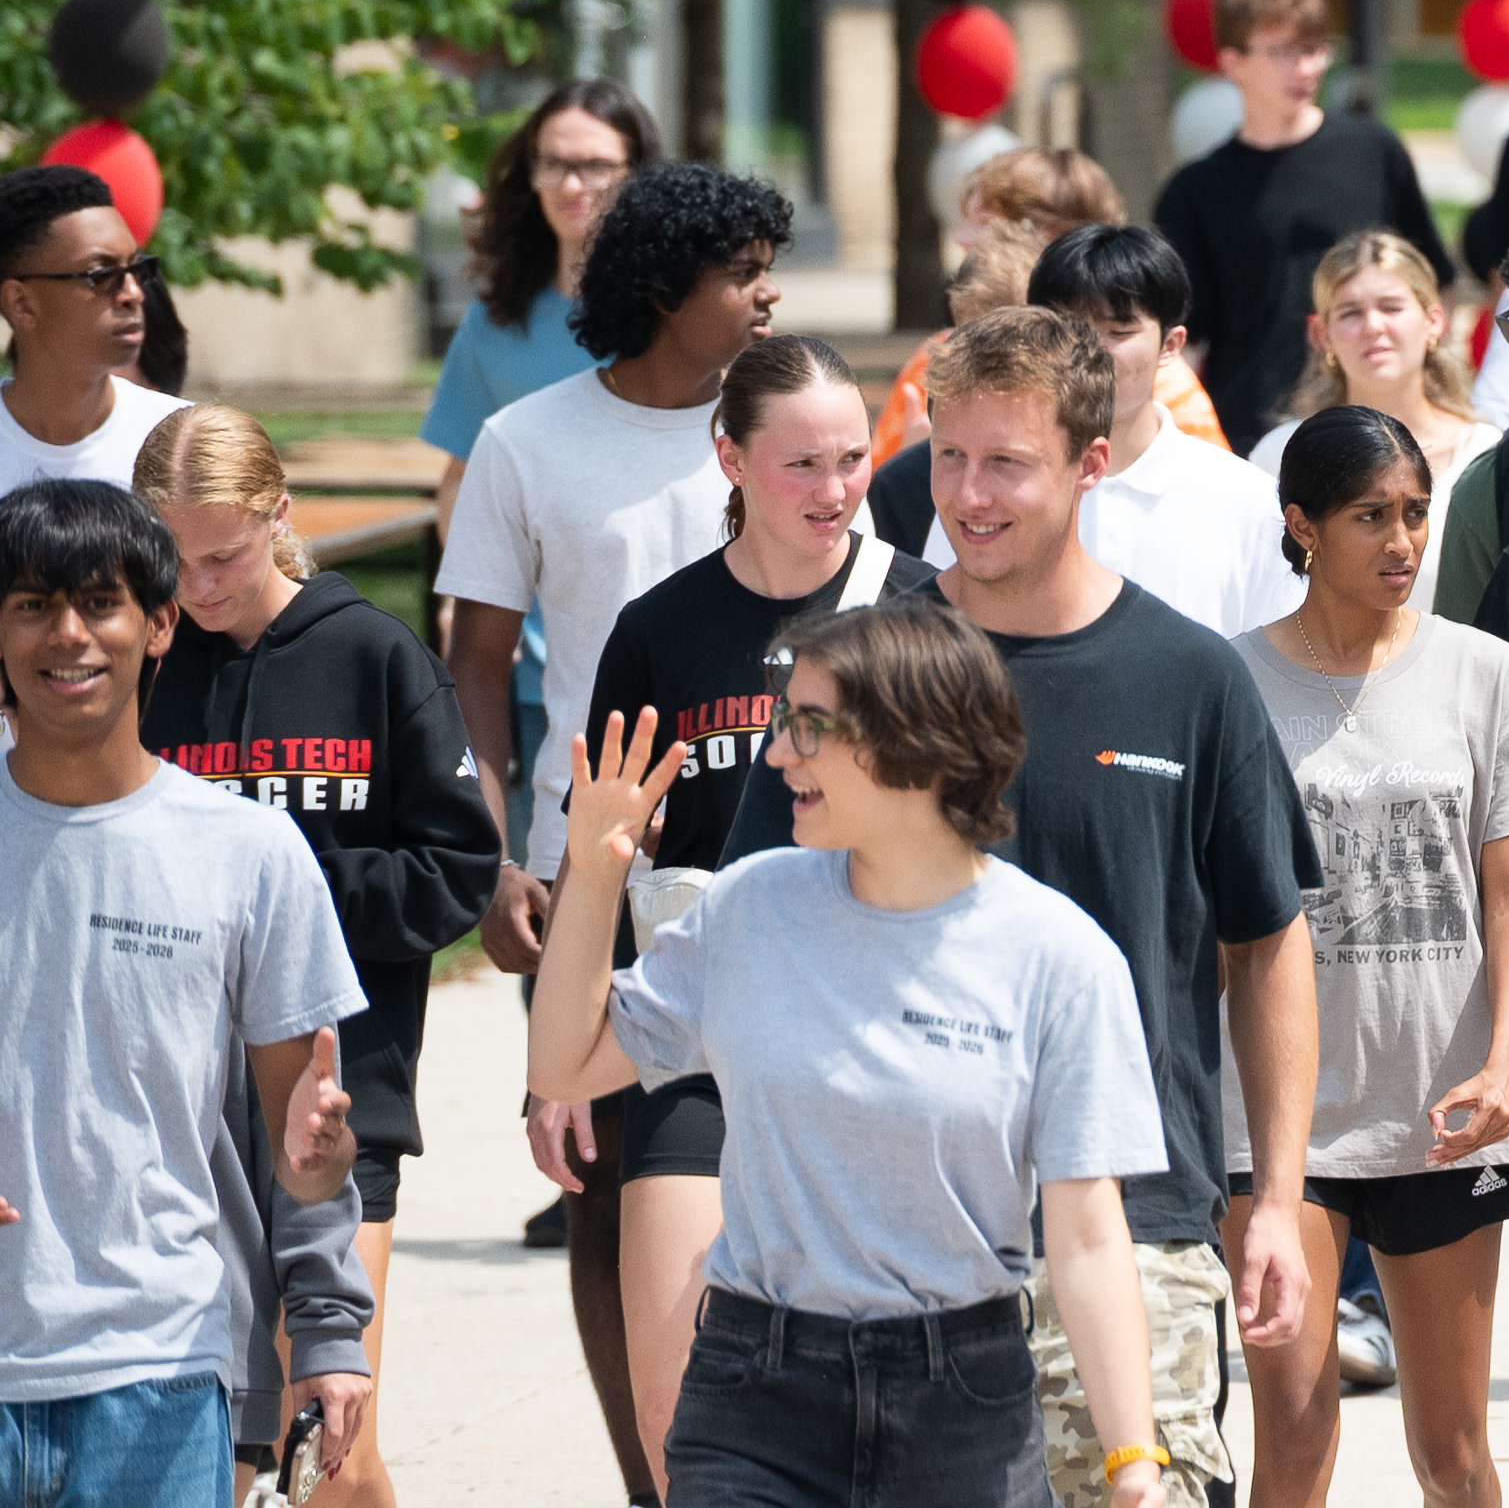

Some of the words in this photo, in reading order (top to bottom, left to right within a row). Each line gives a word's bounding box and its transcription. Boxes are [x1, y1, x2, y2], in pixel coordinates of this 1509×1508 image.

[677, 694, 780, 741] ILLINO
[1271, 715, 1328, 742] AIN
[280, 738, 372, 771] TECH
[1315, 764, 1382, 797] Vinyl
[1385, 760, 1466, 788] Records
[89, 913, 143, 935] RESIDENCE
[147, 922, 168, 939] LIFE
[171, 925, 202, 945] STAFF
[1337, 950, 1370, 964] NEW
[1375, 948, 1422, 963] YORK
[1427, 946, 1464, 961] CITY
[1471, 1178, 1508, 1196] adidas
